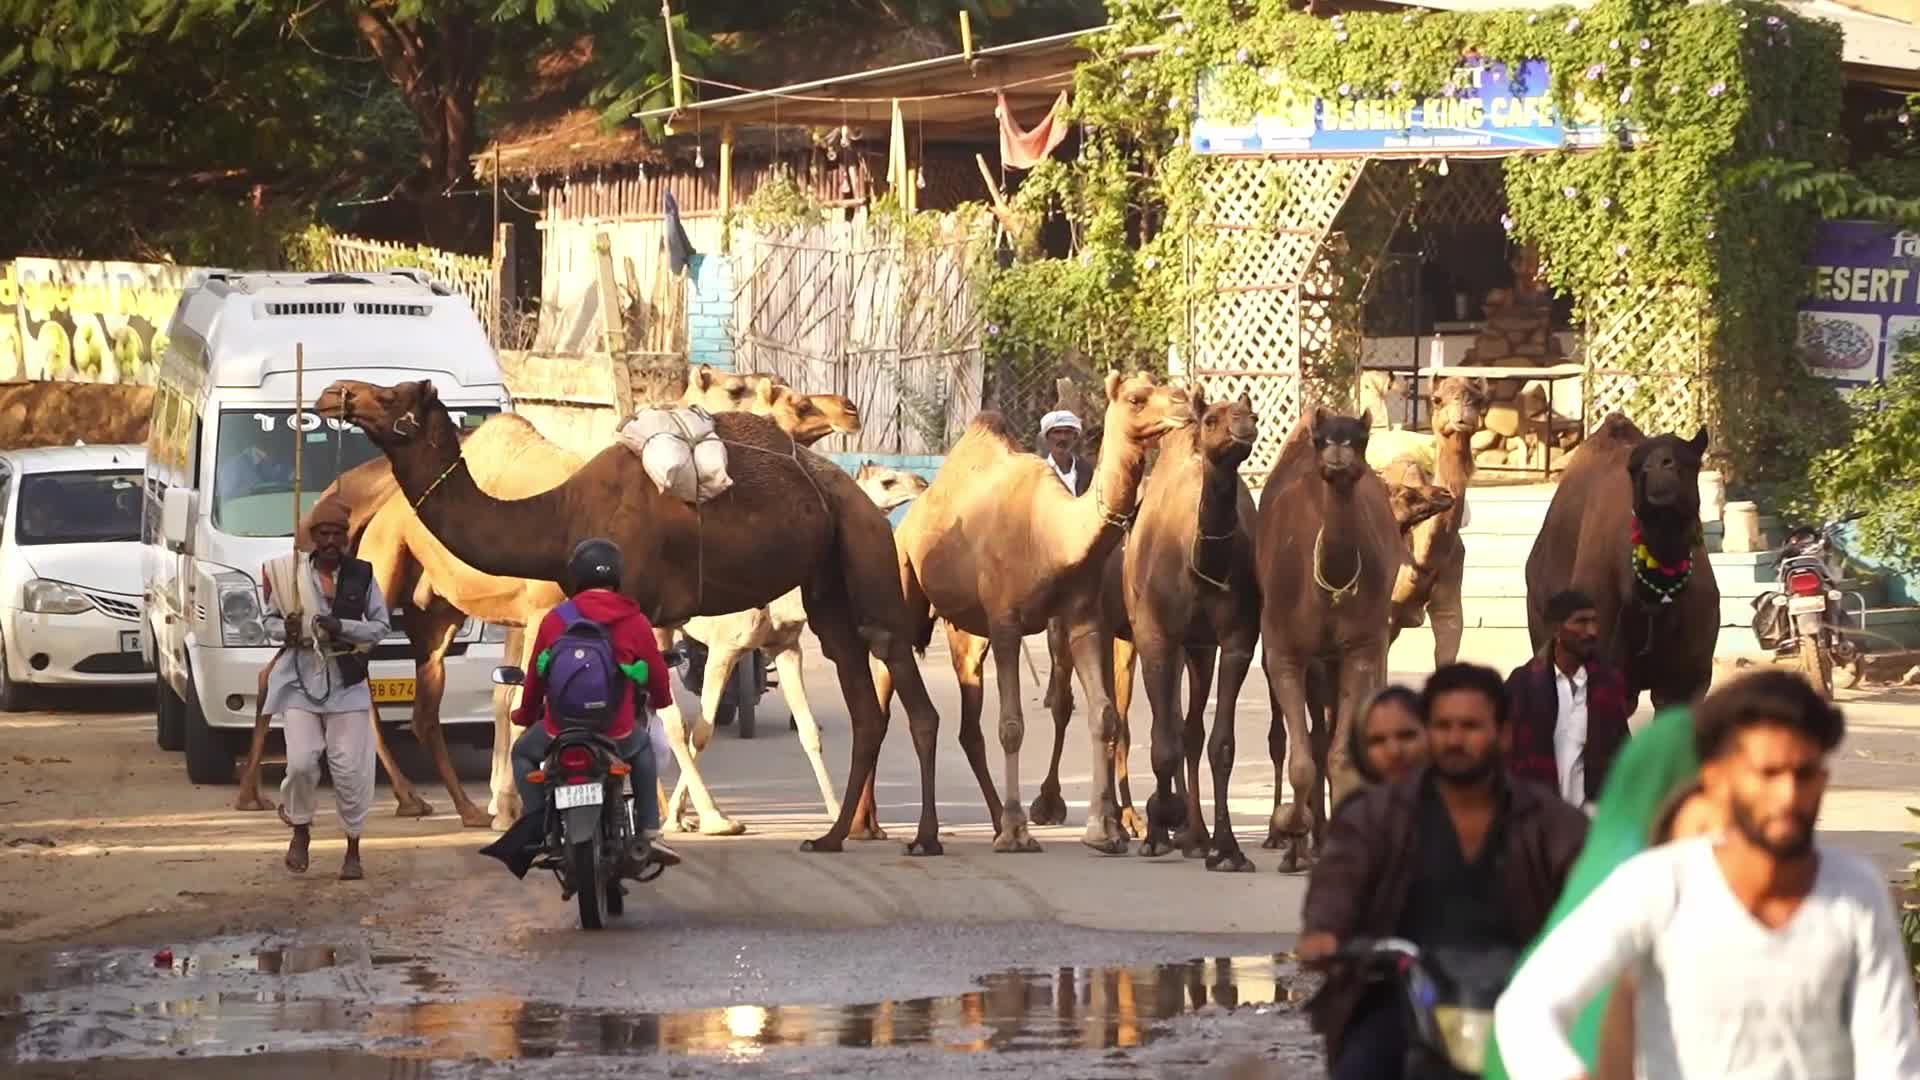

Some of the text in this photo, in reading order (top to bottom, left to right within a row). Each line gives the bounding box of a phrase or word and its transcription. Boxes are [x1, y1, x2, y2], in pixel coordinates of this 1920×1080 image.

[1323, 99, 1416, 130] DESERT
[1423, 97, 1483, 129] KING
[1806, 266, 1909, 303] ESERT
